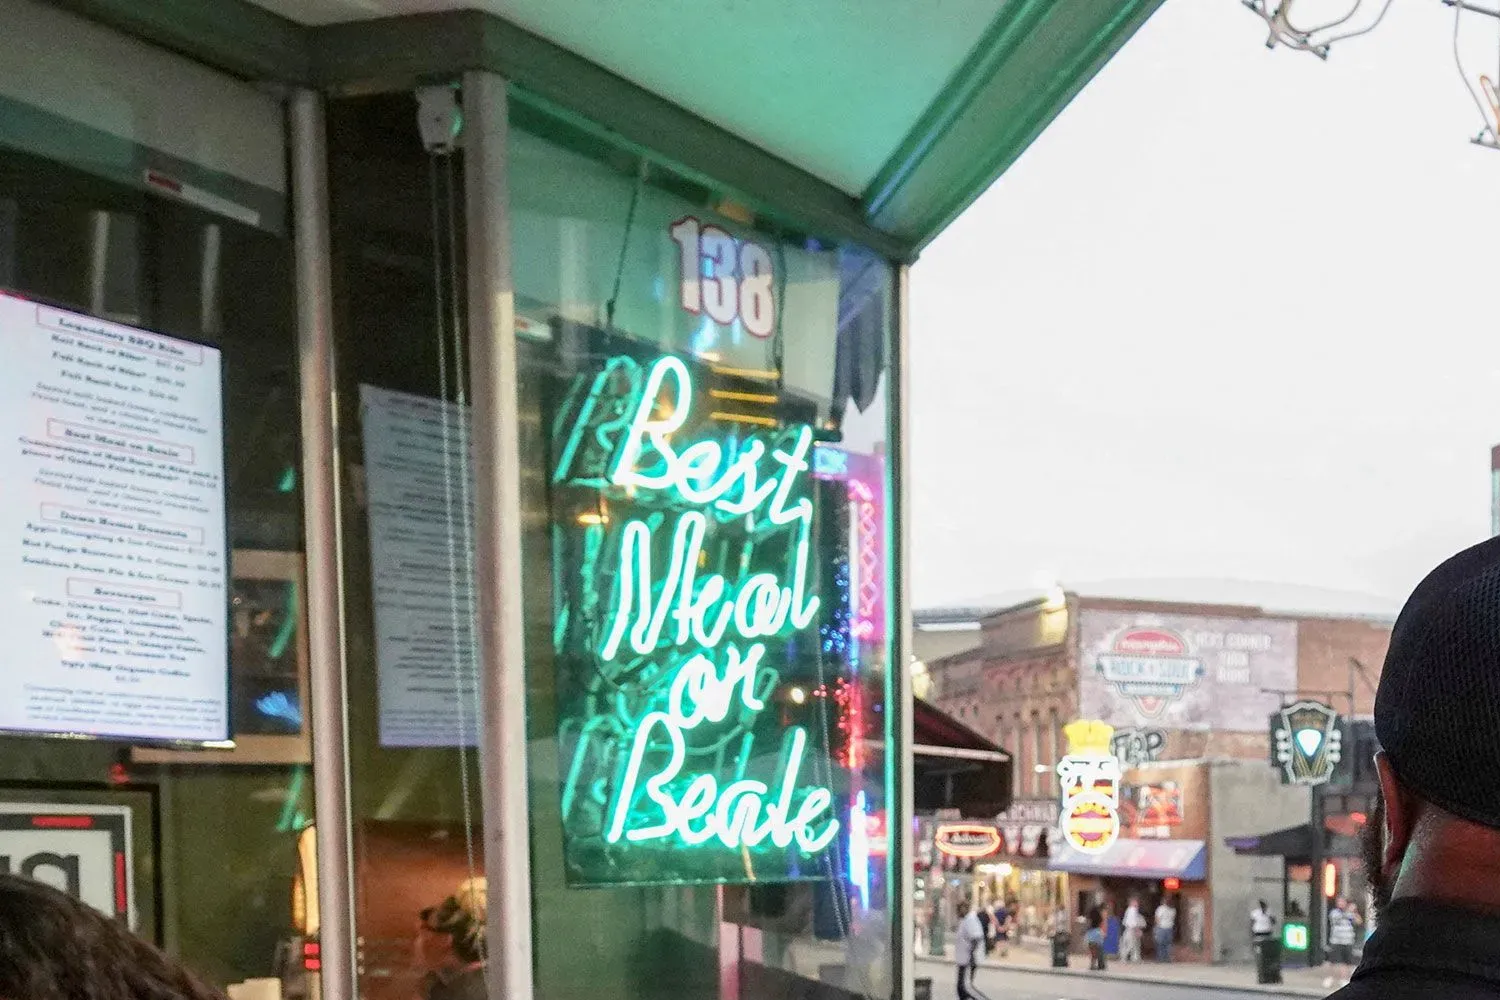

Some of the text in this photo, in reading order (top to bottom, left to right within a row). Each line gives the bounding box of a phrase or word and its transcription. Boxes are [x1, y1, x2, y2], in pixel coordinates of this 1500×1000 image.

[670, 215, 776, 339] 138
[610, 354, 813, 524] Best
[602, 505, 820, 661] Meal
[668, 641, 765, 731] on
[606, 708, 840, 852] Beale
